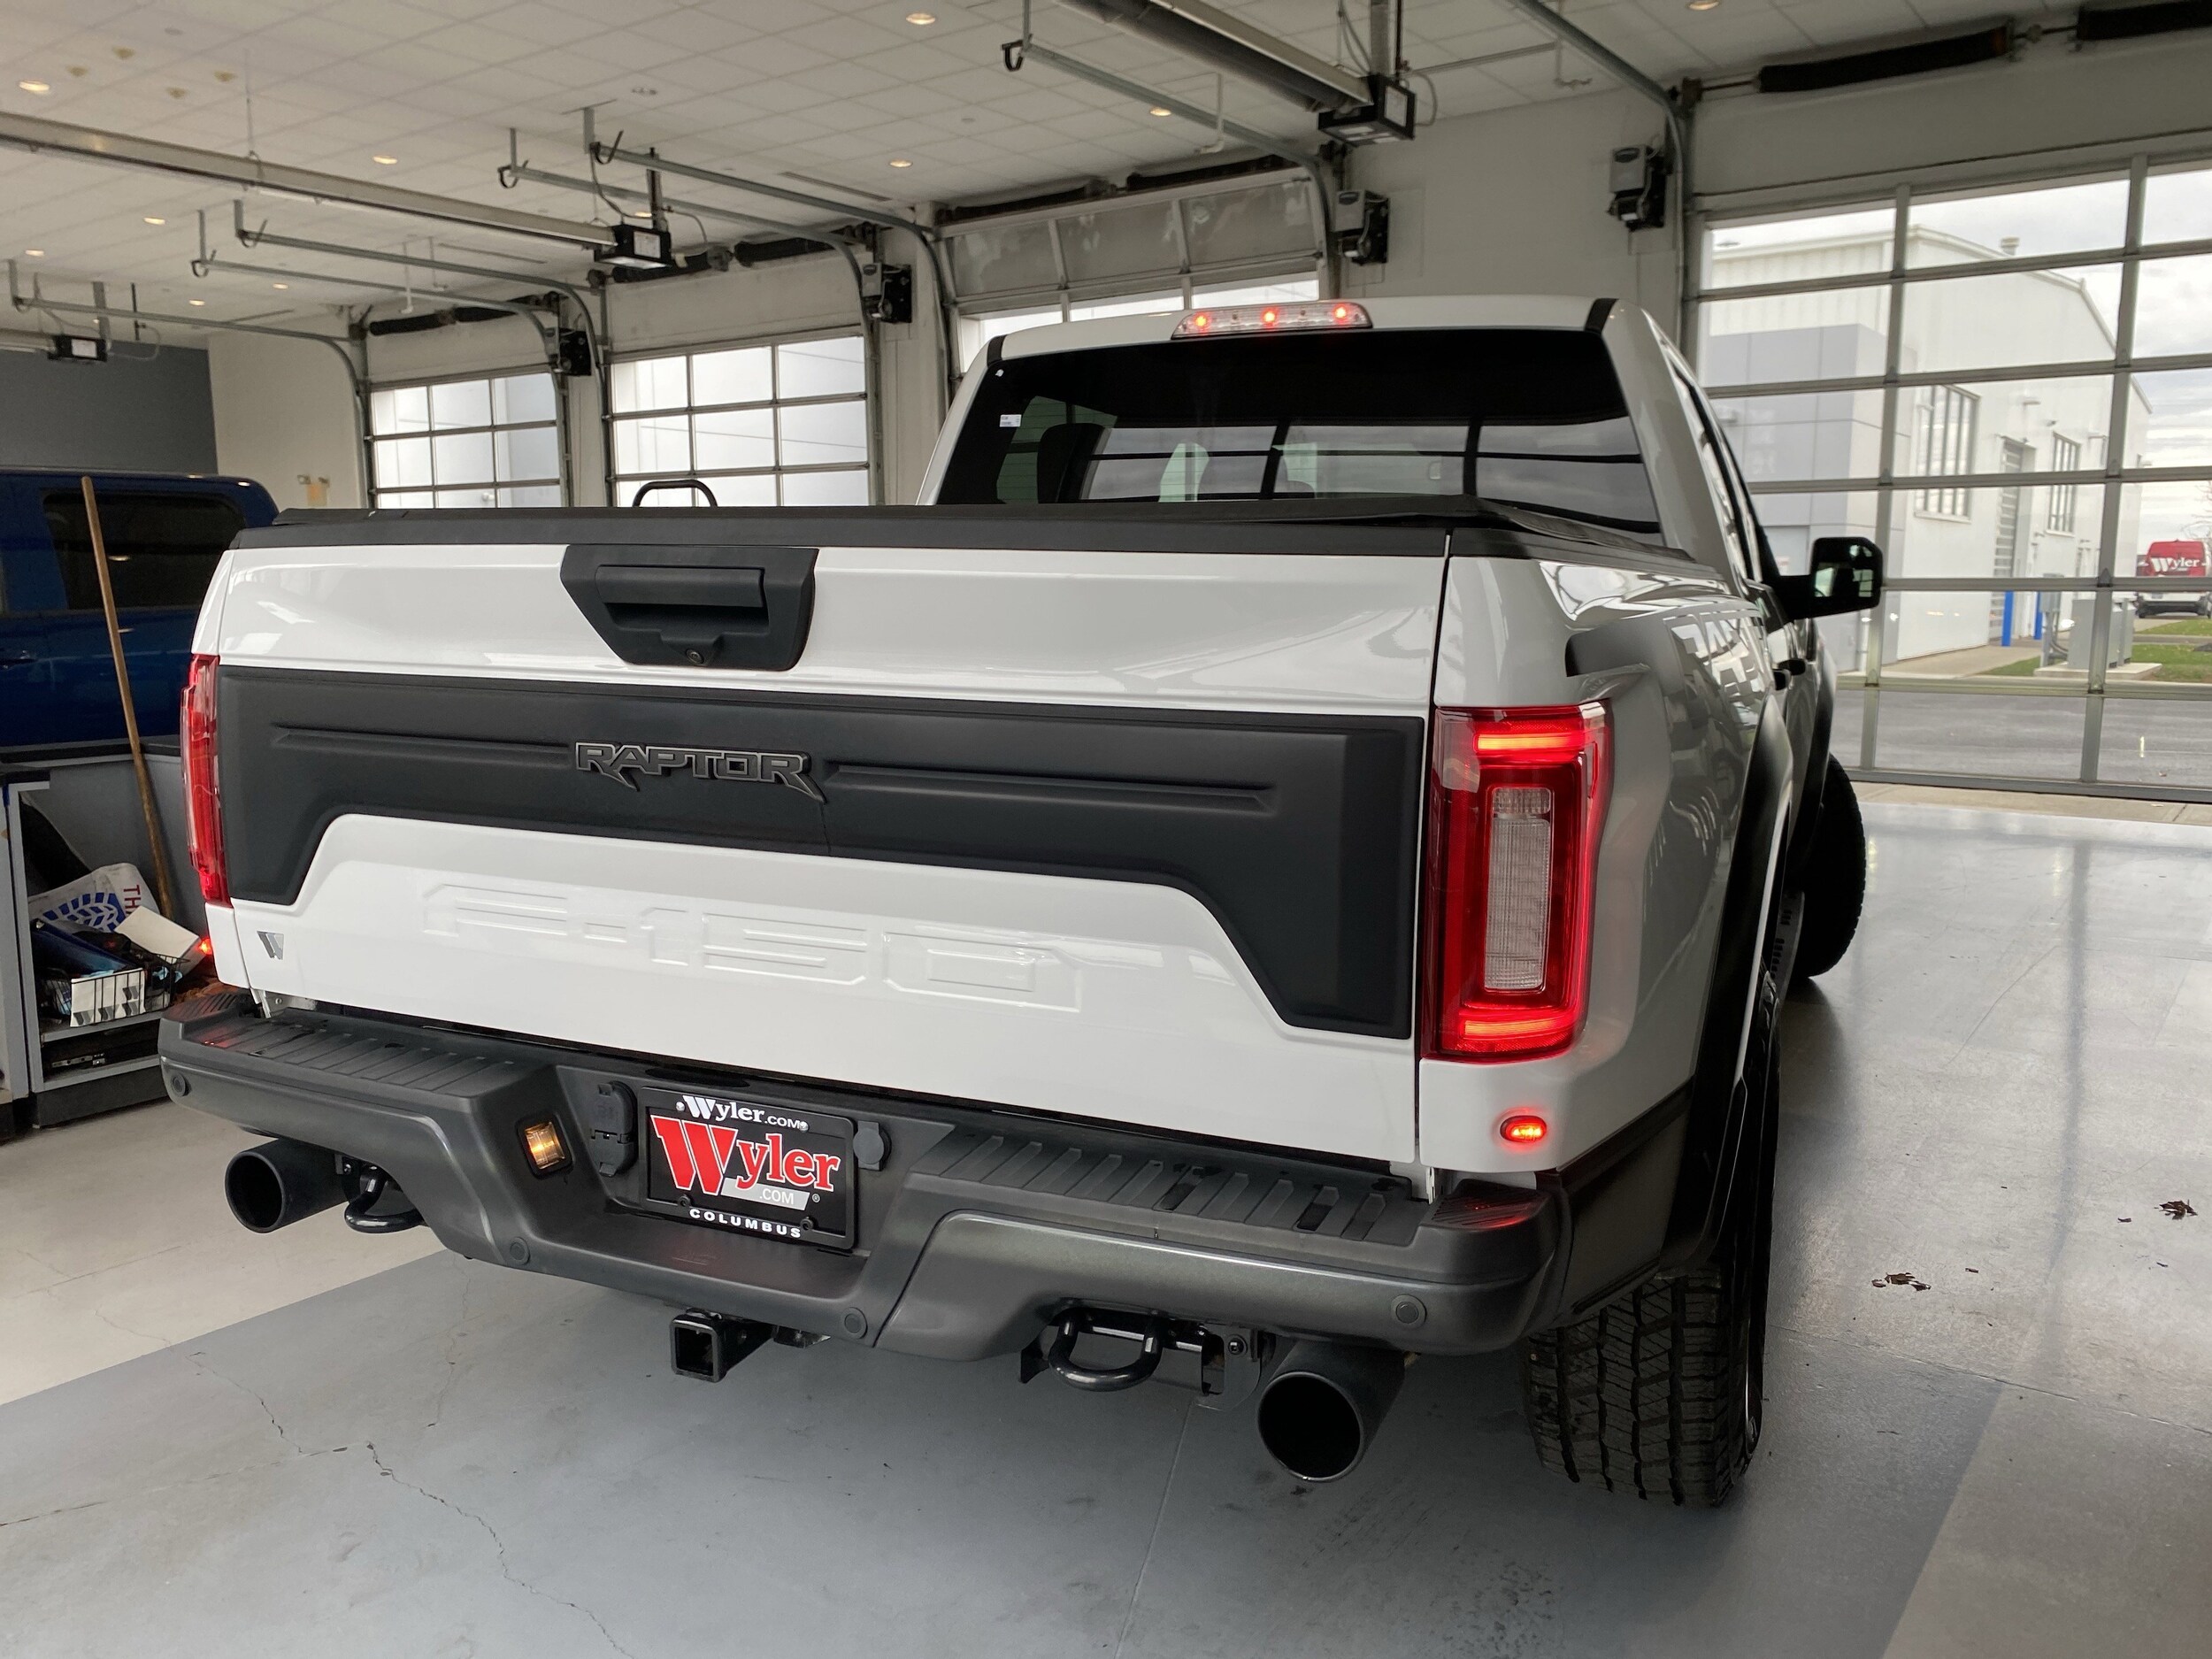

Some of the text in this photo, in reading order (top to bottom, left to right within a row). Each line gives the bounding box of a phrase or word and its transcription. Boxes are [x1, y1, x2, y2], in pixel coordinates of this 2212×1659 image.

[2151, 557, 2200, 572] Wyler
[575, 741, 827, 803] RAPTOR
[124, 884, 142, 915] TH
[423, 883, 1082, 1013] F-150
[650, 1115, 841, 1196] Wyler
[689, 1209, 801, 1239] COLUMBUS
